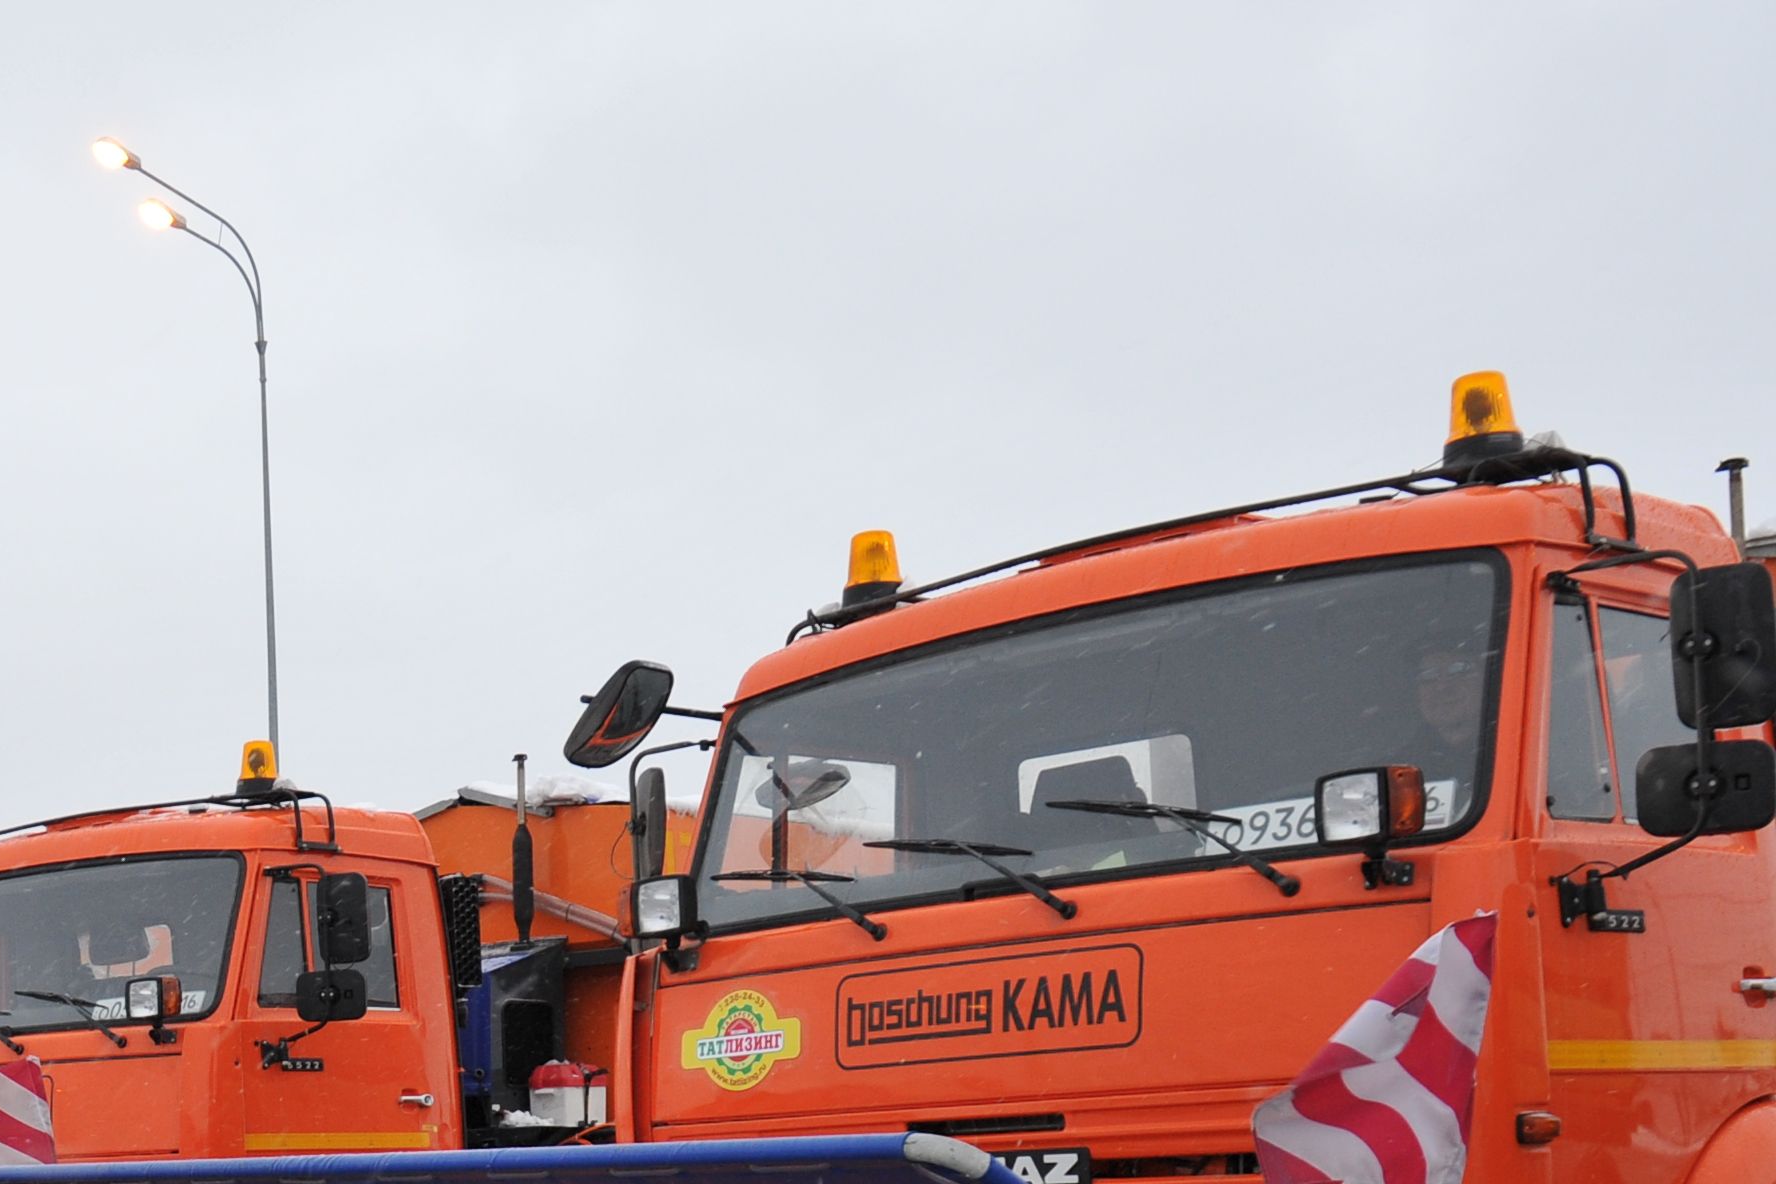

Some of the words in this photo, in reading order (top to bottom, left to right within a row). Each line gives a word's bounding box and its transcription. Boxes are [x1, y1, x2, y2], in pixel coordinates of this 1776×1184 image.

[846, 989, 993, 1047] boschung
[1002, 968, 1126, 1032] KAMA
[698, 1033, 782, 1057] ТАТЛИЗИНГ
